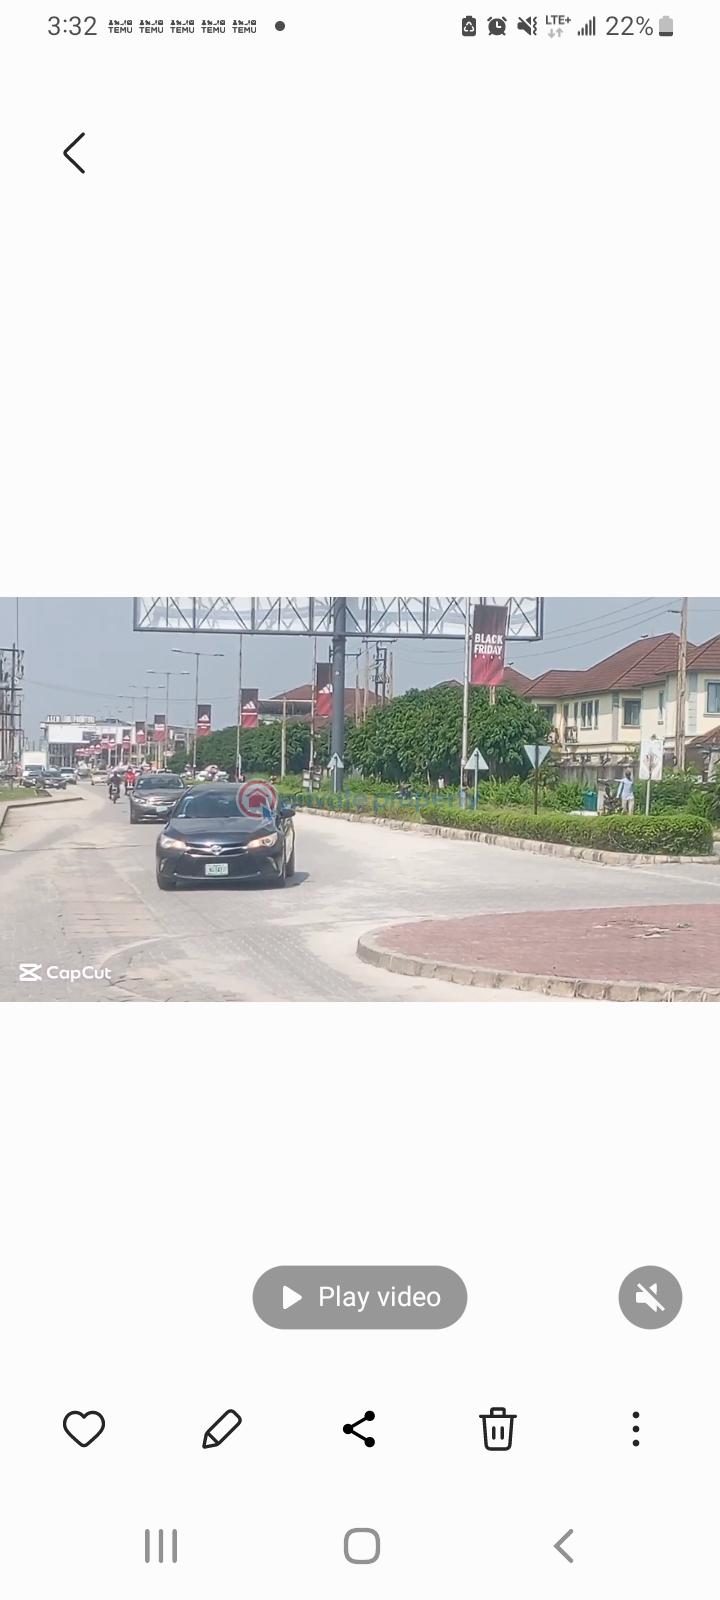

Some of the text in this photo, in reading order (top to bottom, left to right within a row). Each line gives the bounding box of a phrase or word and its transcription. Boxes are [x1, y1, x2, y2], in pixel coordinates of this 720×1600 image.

[545, 14, 572, 25] LTE+
[47, 15, 98, 36] 3:32
[108, 26, 257, 34] TEMU TEMU TEMU TEMU TEMU
[605, 15, 654, 36] 22%
[474, 633, 503, 644] BLACK
[474, 644, 503, 655] FRIDAY
[319, 1285, 441, 1313] Play video
